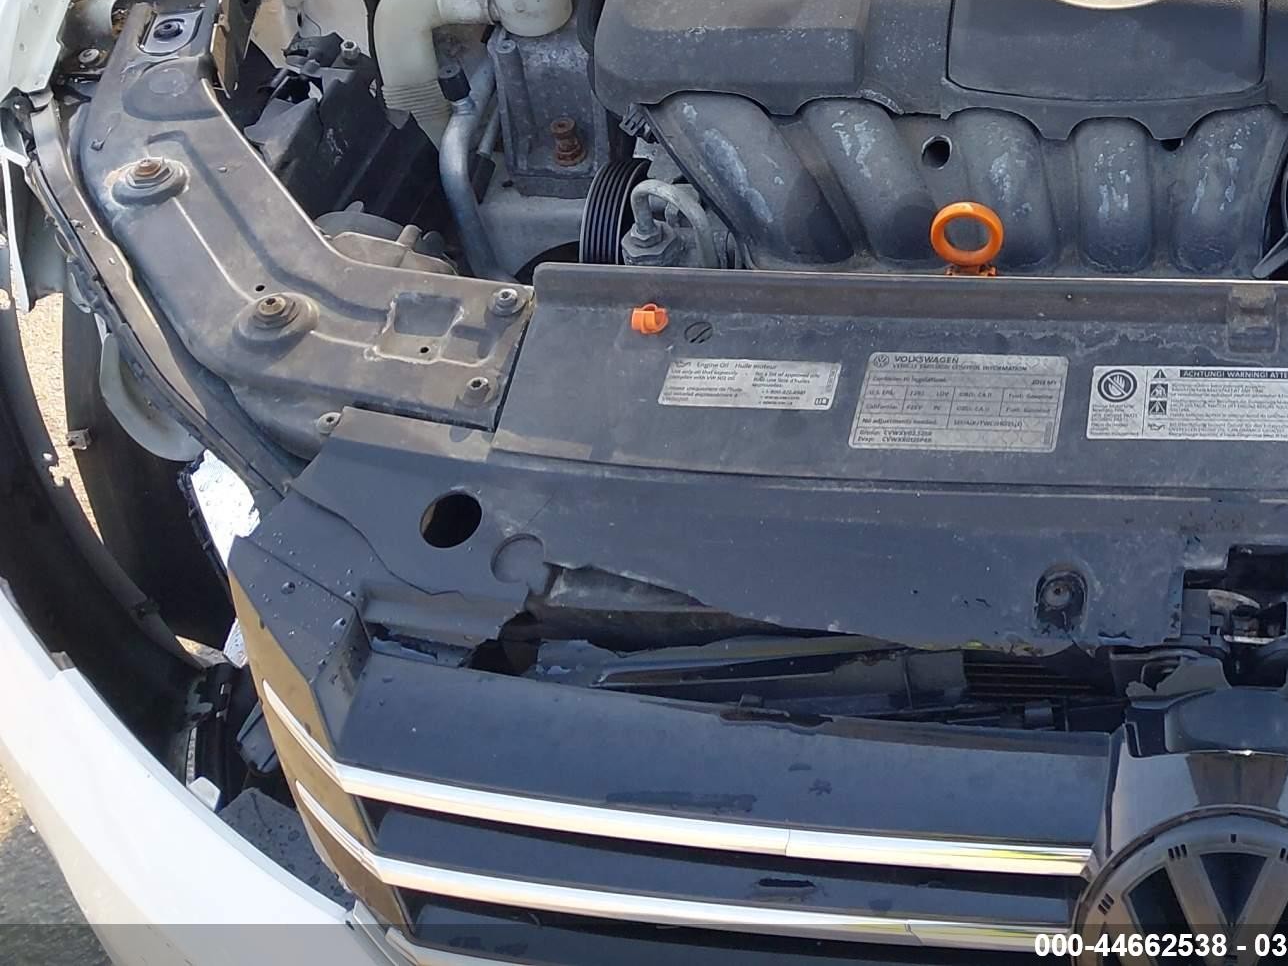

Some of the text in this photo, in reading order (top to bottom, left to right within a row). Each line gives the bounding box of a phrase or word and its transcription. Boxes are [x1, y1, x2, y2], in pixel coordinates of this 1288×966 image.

[894, 355, 959, 364] VOLKSWAGEN
[697, 362, 718, 370] Engine
[1183, 369, 1225, 379] ACHTUNG!
[1226, 370, 1268, 379] WARNING!
